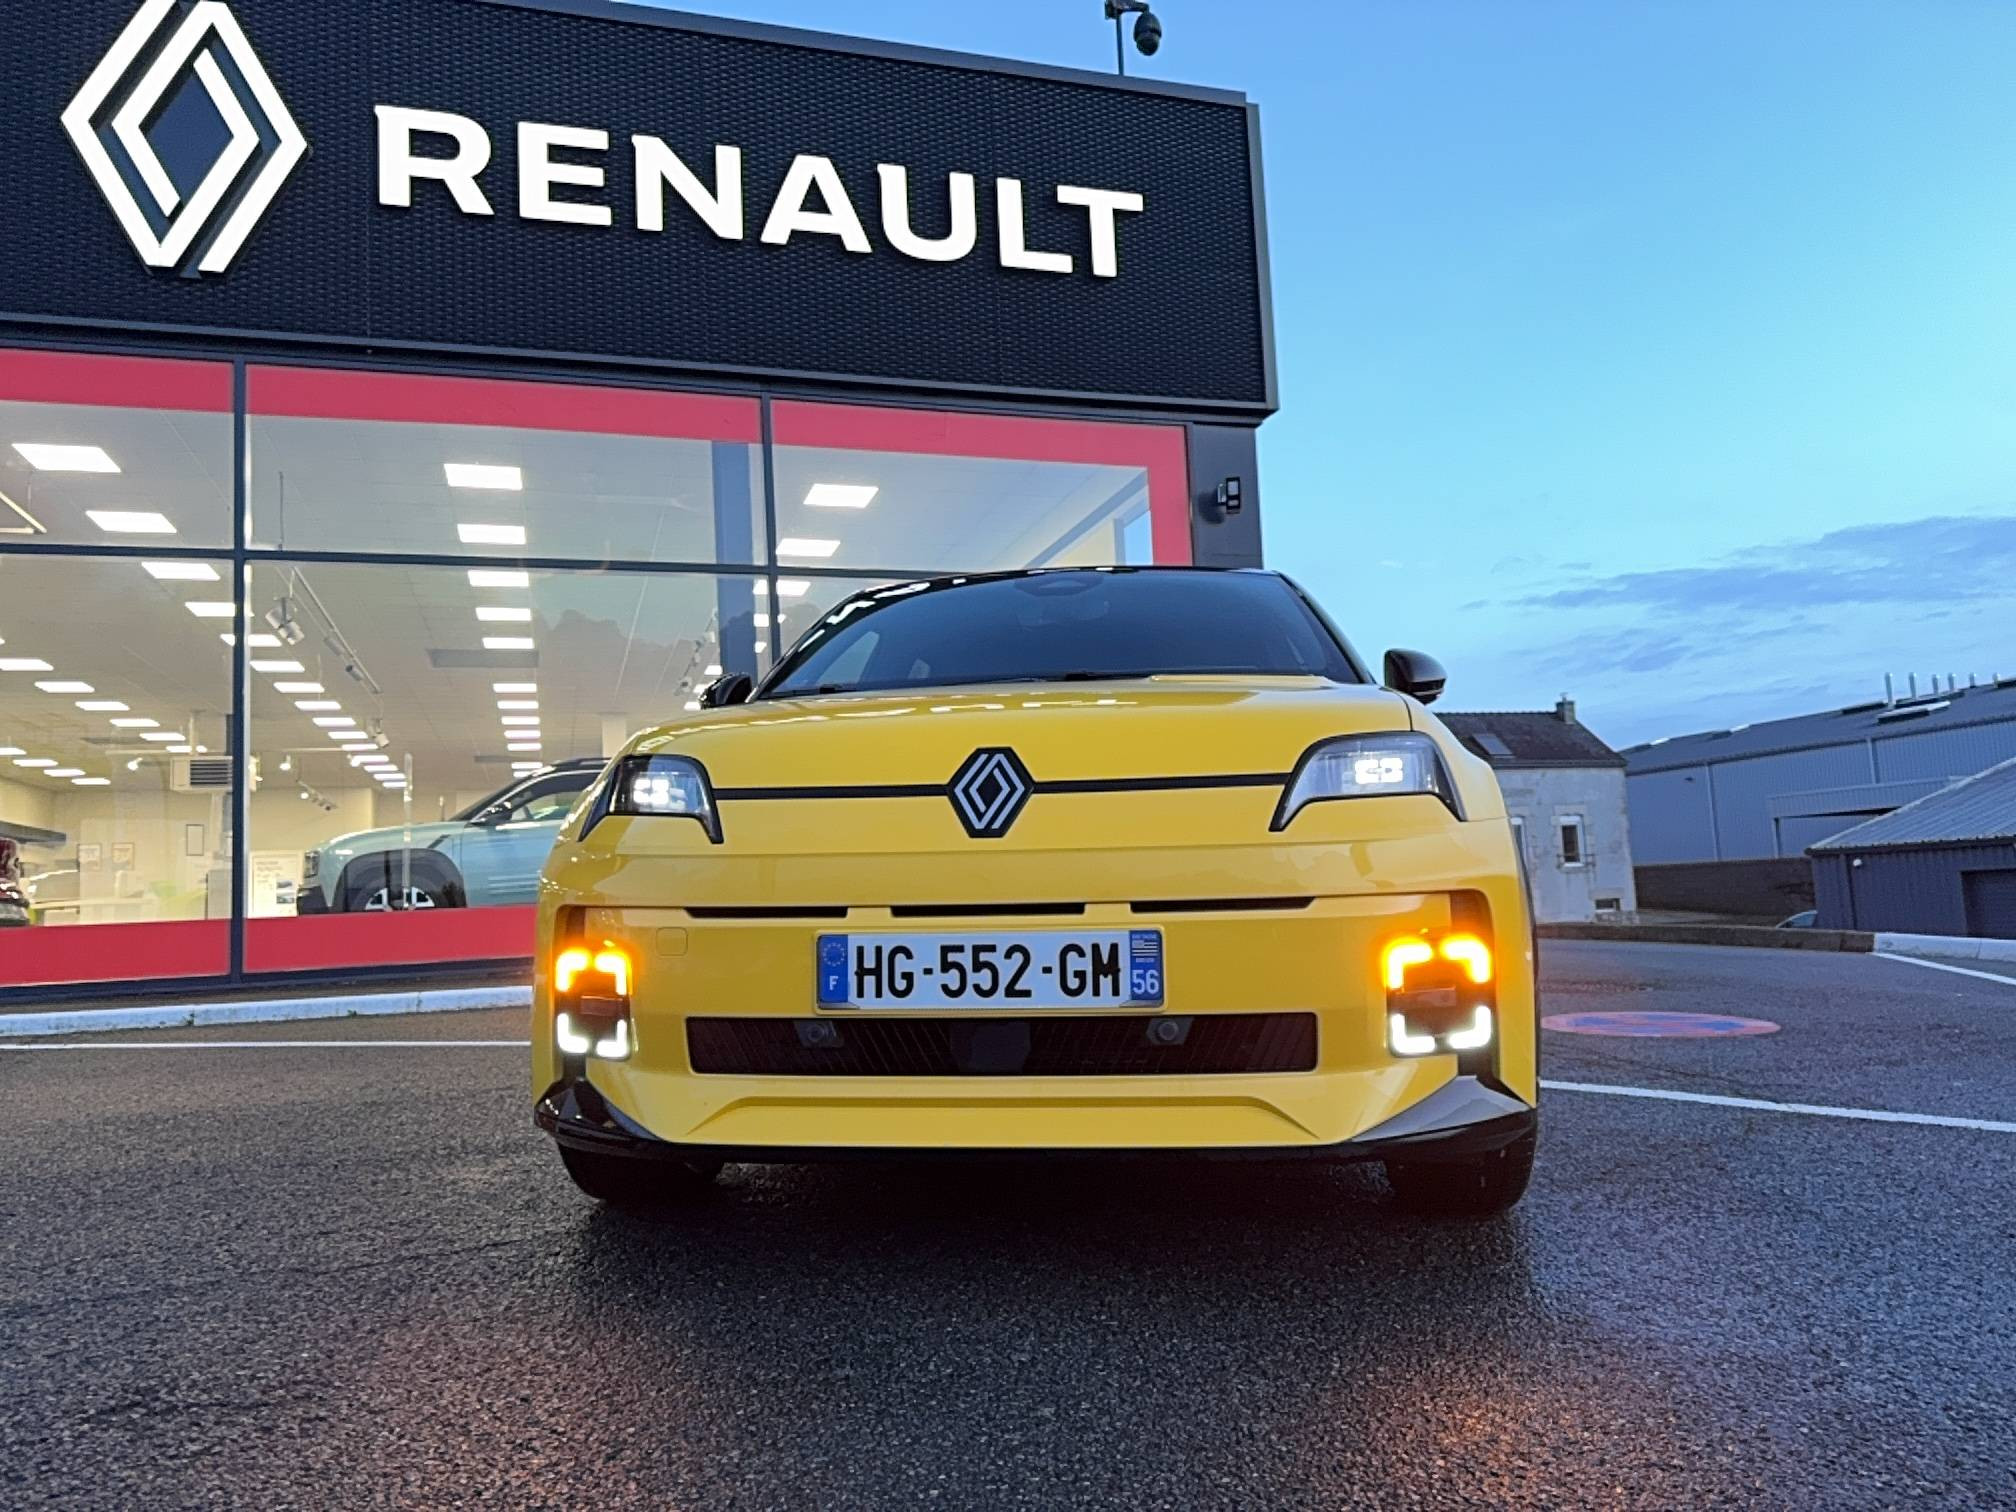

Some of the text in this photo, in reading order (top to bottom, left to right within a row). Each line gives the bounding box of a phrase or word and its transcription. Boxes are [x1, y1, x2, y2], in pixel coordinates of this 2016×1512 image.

[374, 104, 1144, 278] RENAULT
[829, 975, 839, 991] F
[855, 943, 1121, 999] HG-552-GM
[1131, 969, 1160, 995] 56
